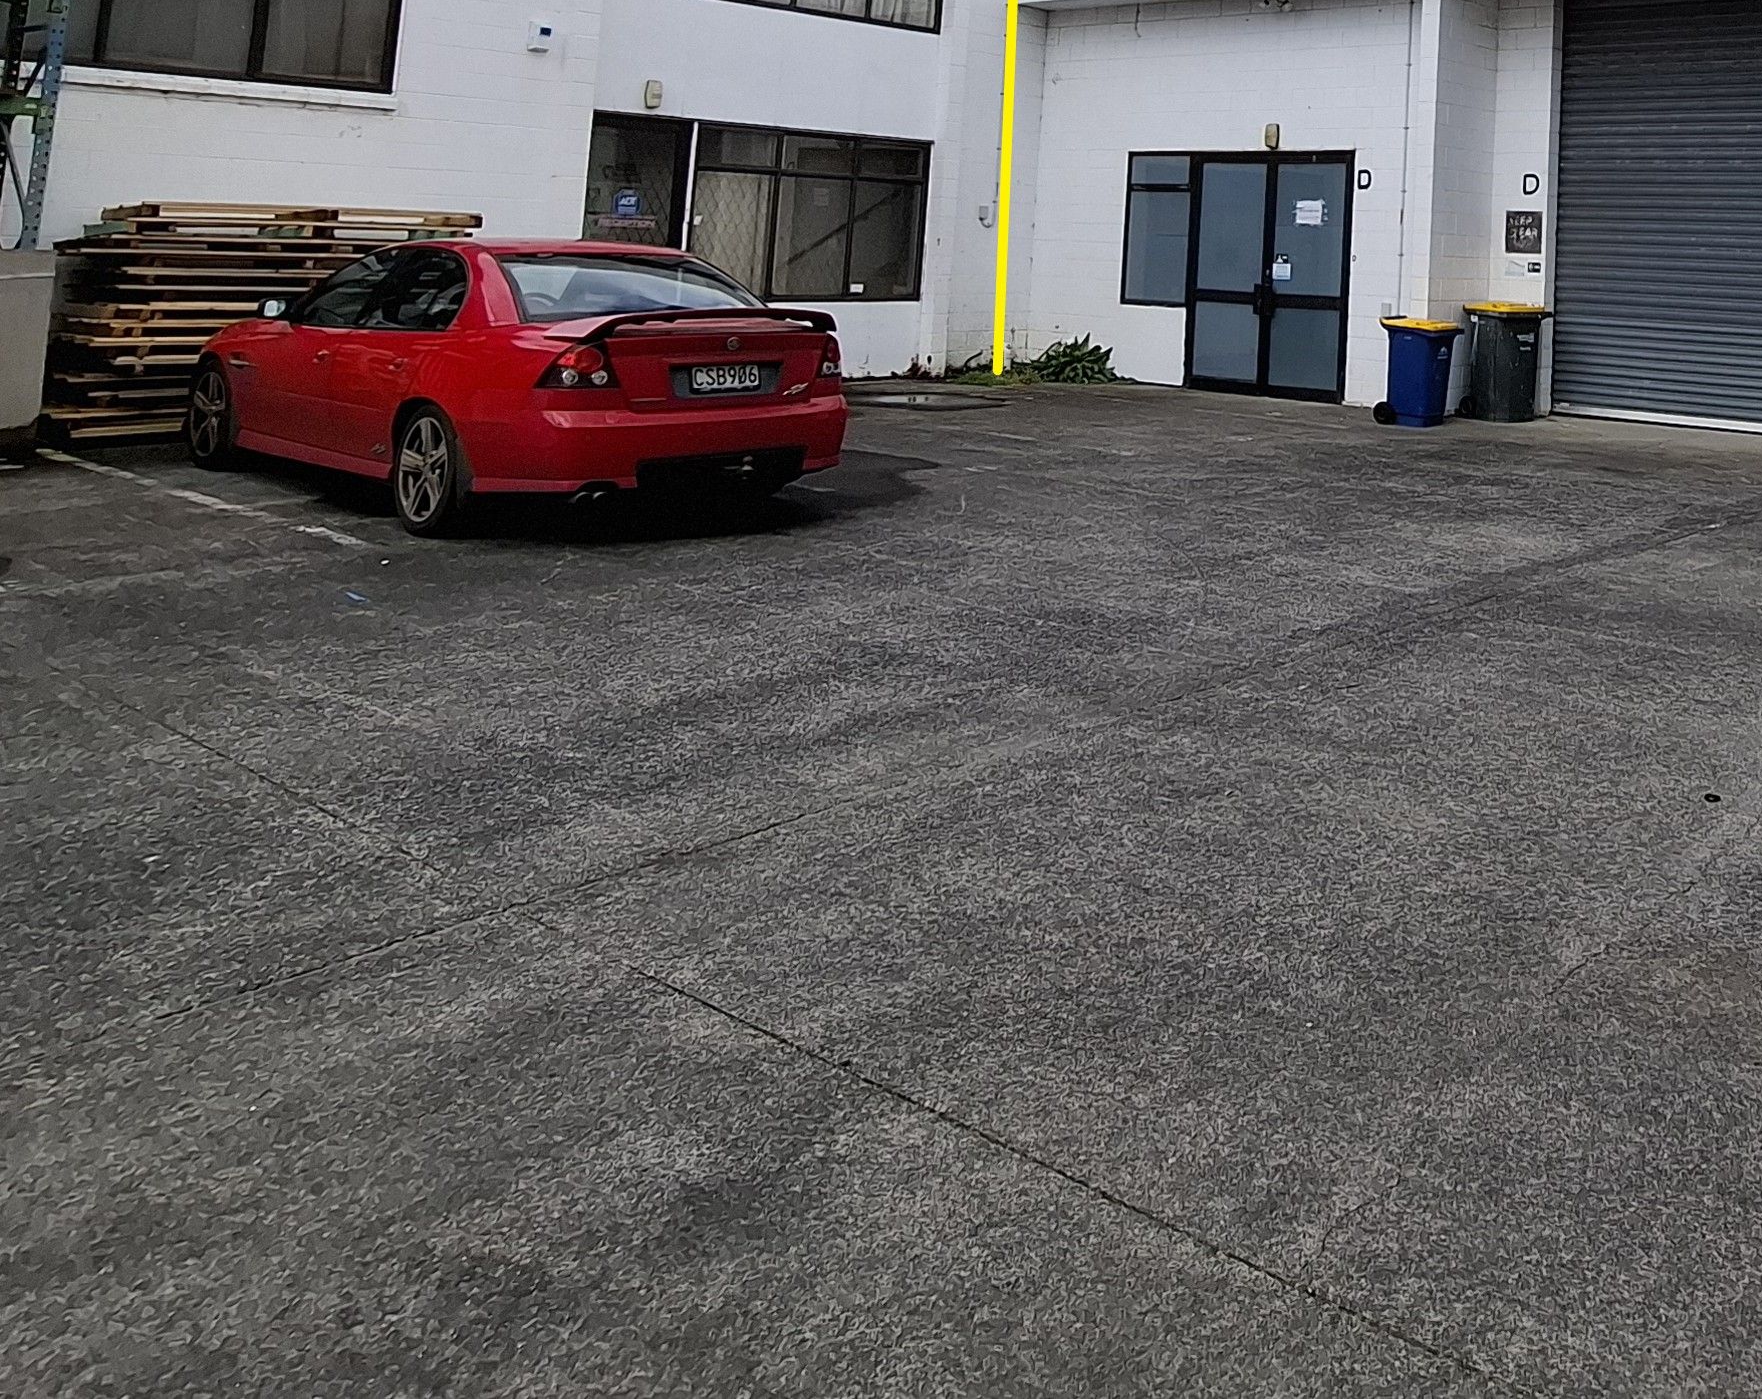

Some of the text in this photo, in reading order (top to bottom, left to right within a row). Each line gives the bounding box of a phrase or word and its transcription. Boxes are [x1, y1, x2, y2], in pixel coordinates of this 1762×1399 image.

[1357, 169, 1372, 190] D
[1522, 173, 1540, 195] D
[694, 366, 758, 387] CSB906
